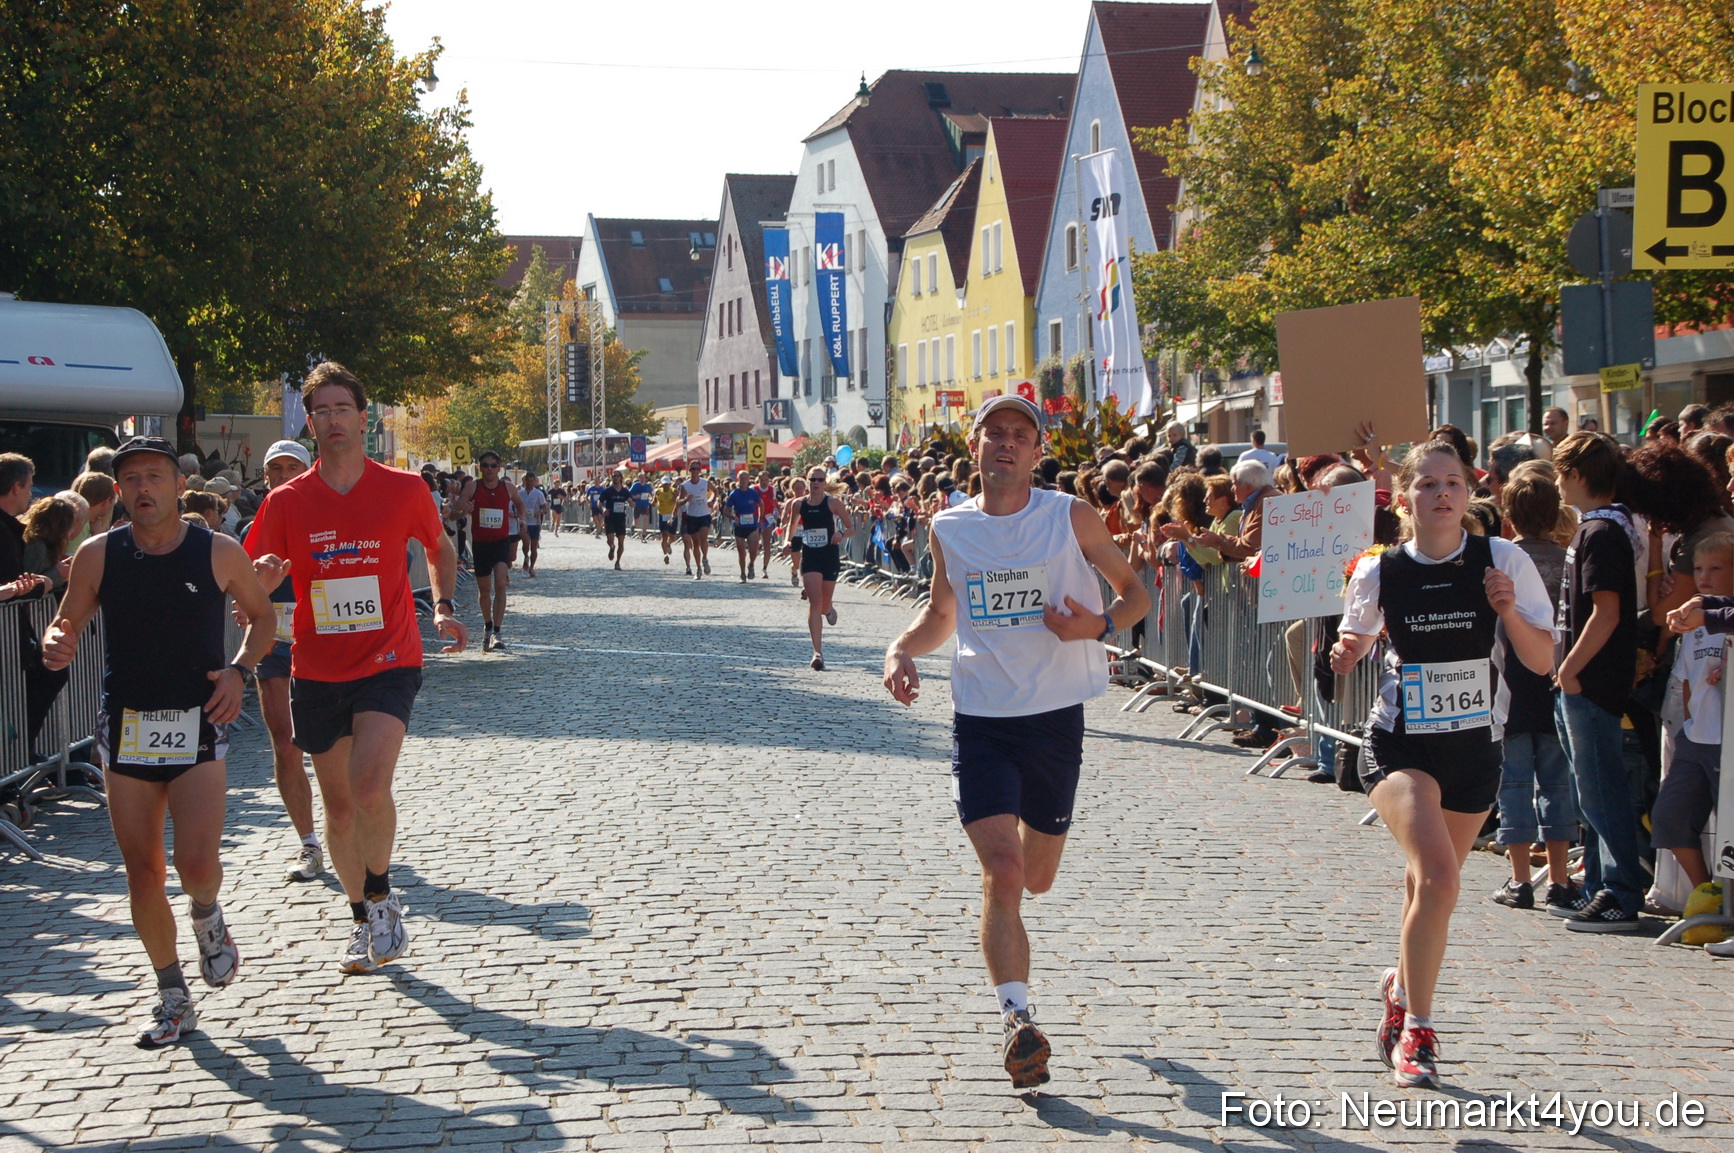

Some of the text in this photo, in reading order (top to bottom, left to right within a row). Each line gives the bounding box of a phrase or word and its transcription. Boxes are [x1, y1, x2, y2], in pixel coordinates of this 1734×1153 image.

[1653, 91, 1734, 124] Bloc
[1666, 140, 1727, 228] B
[1611, 191, 1634, 204] Ulme
[829, 273, 842, 358] K&L RUPPERT
[921, 314, 939, 334] HOTEL
[455, 445, 465, 460] C
[631, 453, 646, 461] TAXI
[752, 444, 762, 459] C
[486, 516, 501, 524] 1157
[1268, 498, 1351, 527] Go Steffi Go
[310, 535, 337, 544] Marathon
[809, 534, 826, 542] 3229
[323, 540, 380, 552] 28. Mai 2006
[1264, 534, 1349, 563] Go Michael Go
[986, 569, 1029, 584] Stephan
[1262, 570, 1343, 598] Go Olli Go
[971, 590, 976, 600] A
[991, 588, 1043, 611] 2772
[333, 599, 376, 617] 1156
[1404, 611, 1477, 624] LLC Marathon
[1411, 621, 1473, 632] Regensburg
[1425, 668, 1476, 683] Veronica
[1407, 691, 1413, 701] A
[1430, 688, 1485, 714] 3164
[142, 710, 182, 722] HELMUT
[1460, 714, 1490, 725] PFLEIDERER
[124, 726, 130, 736] B
[148, 731, 186, 748] 242
